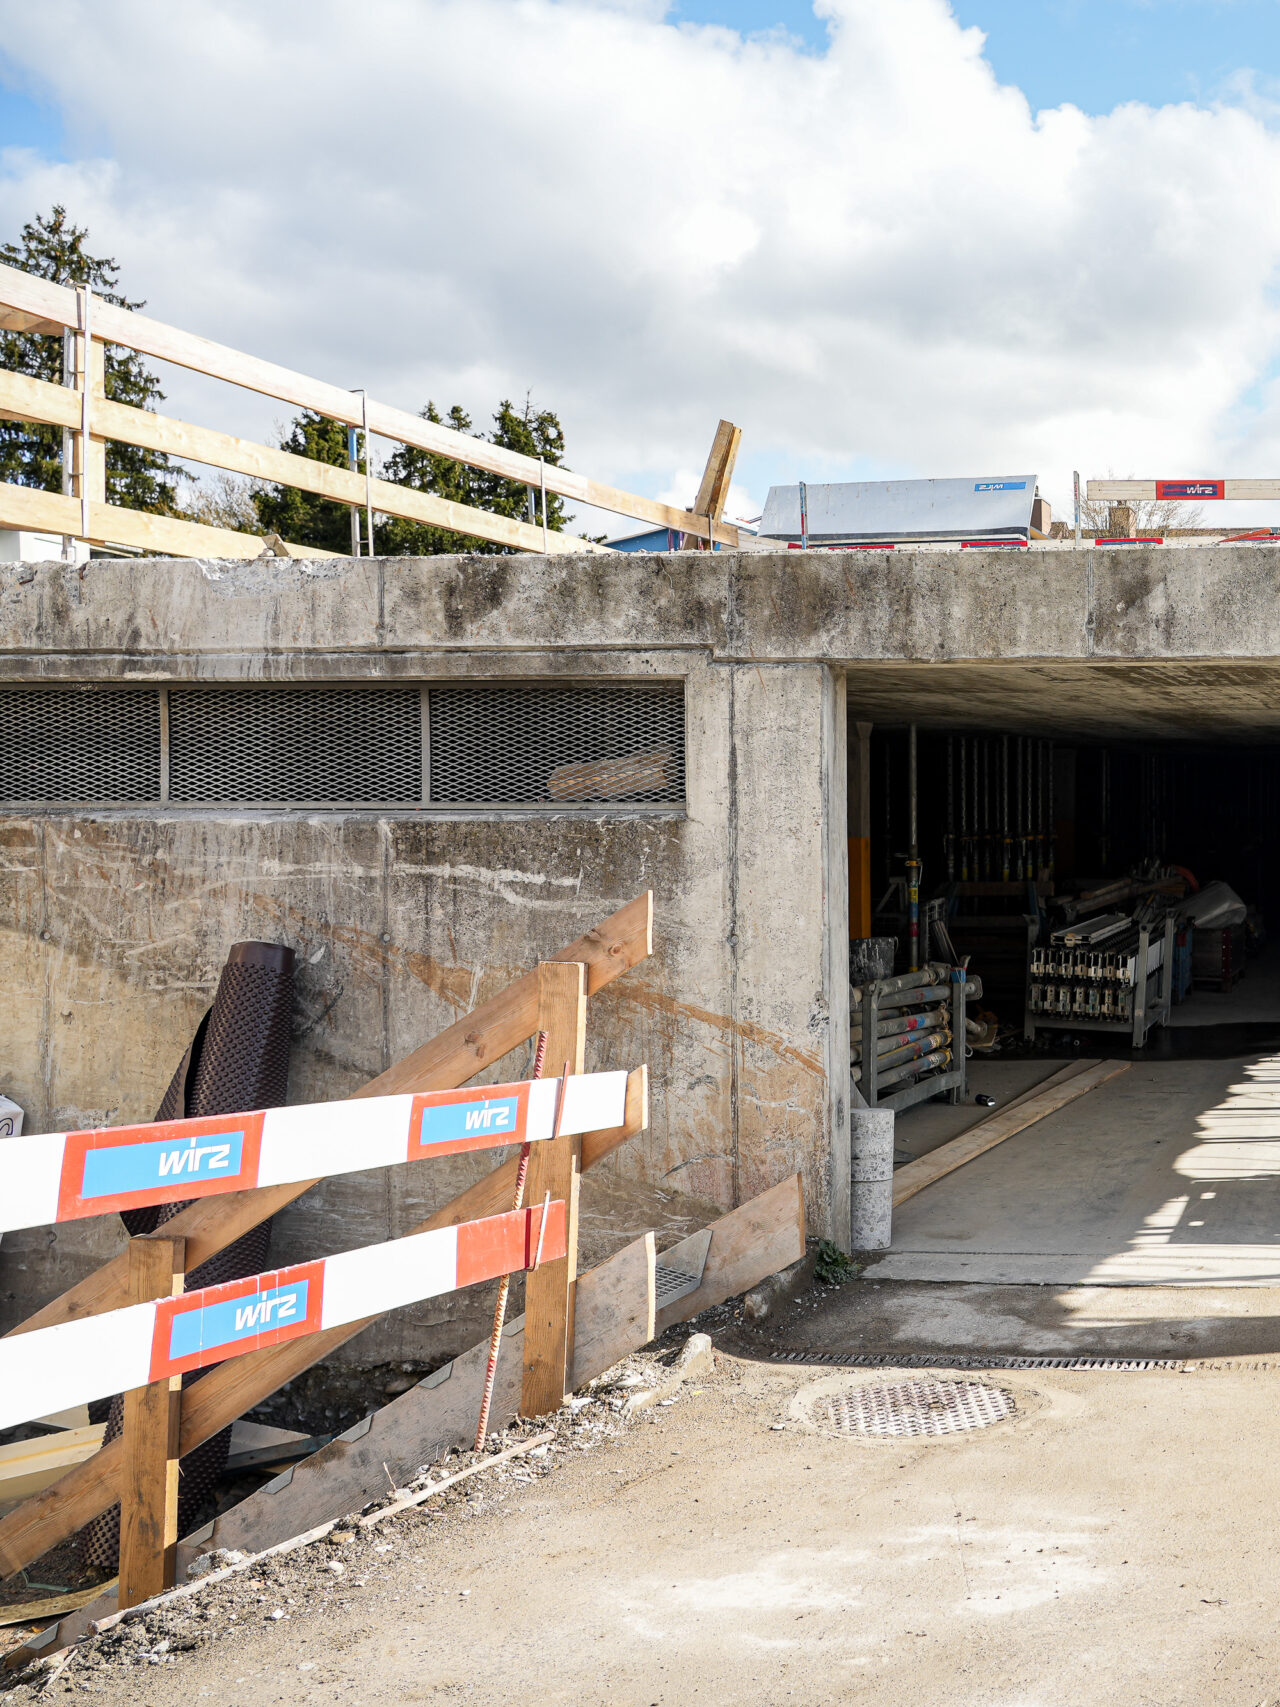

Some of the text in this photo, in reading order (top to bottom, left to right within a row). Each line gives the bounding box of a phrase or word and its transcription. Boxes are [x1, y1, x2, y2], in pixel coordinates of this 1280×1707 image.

[1186, 483, 1213, 494] wirz
[465, 1100, 510, 1130] wirz
[158, 1136, 231, 1176] wirz
[234, 1290, 297, 1331] wirz
